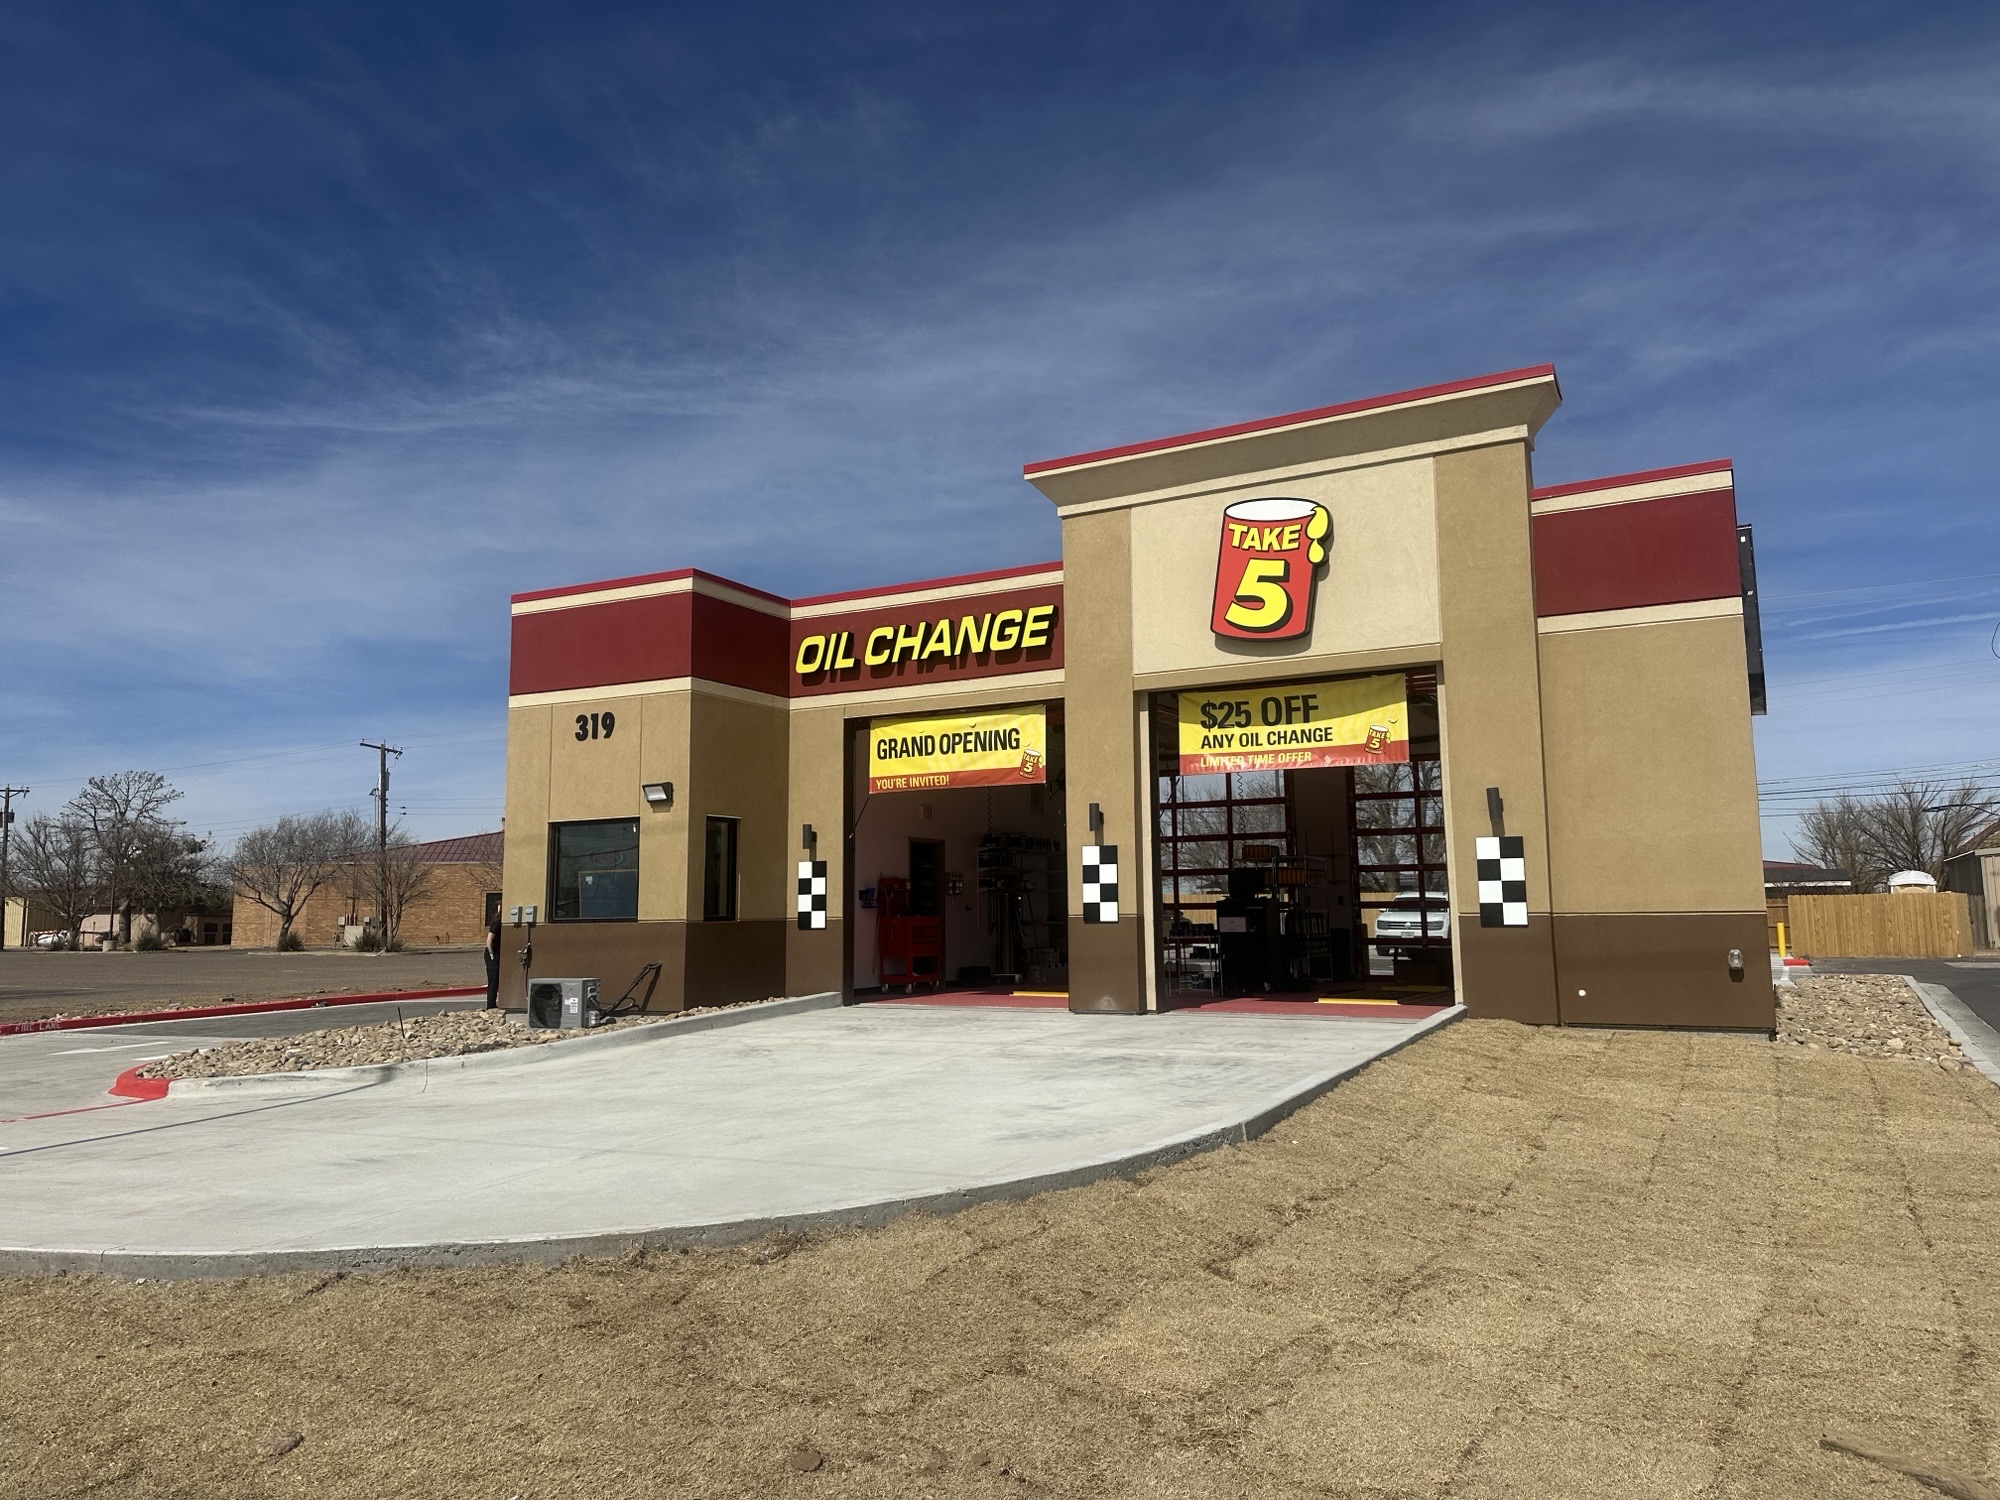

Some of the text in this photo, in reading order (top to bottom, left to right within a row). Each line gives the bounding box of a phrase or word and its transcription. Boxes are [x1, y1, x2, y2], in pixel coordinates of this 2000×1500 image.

[1228, 523, 1302, 552] TAKE
[1224, 558, 1291, 630] 5
[795, 604, 1055, 674] OIL CHANGE
[1200, 694, 1319, 732] $25 OFF
[575, 711, 615, 742] 319
[1368, 729, 1386, 739] TAKE
[877, 728, 1020, 760] GRAND OPENING
[1201, 727, 1333, 749] ANY OIL CHANGE
[1369, 737, 1381, 750] 5
[1023, 761, 1034, 773] 5
[1200, 751, 1312, 768] LIMITED TIME OFFER
[876, 775, 950, 790] YOU'RE INVITED!
[40, 1020, 61, 1031] LANE
